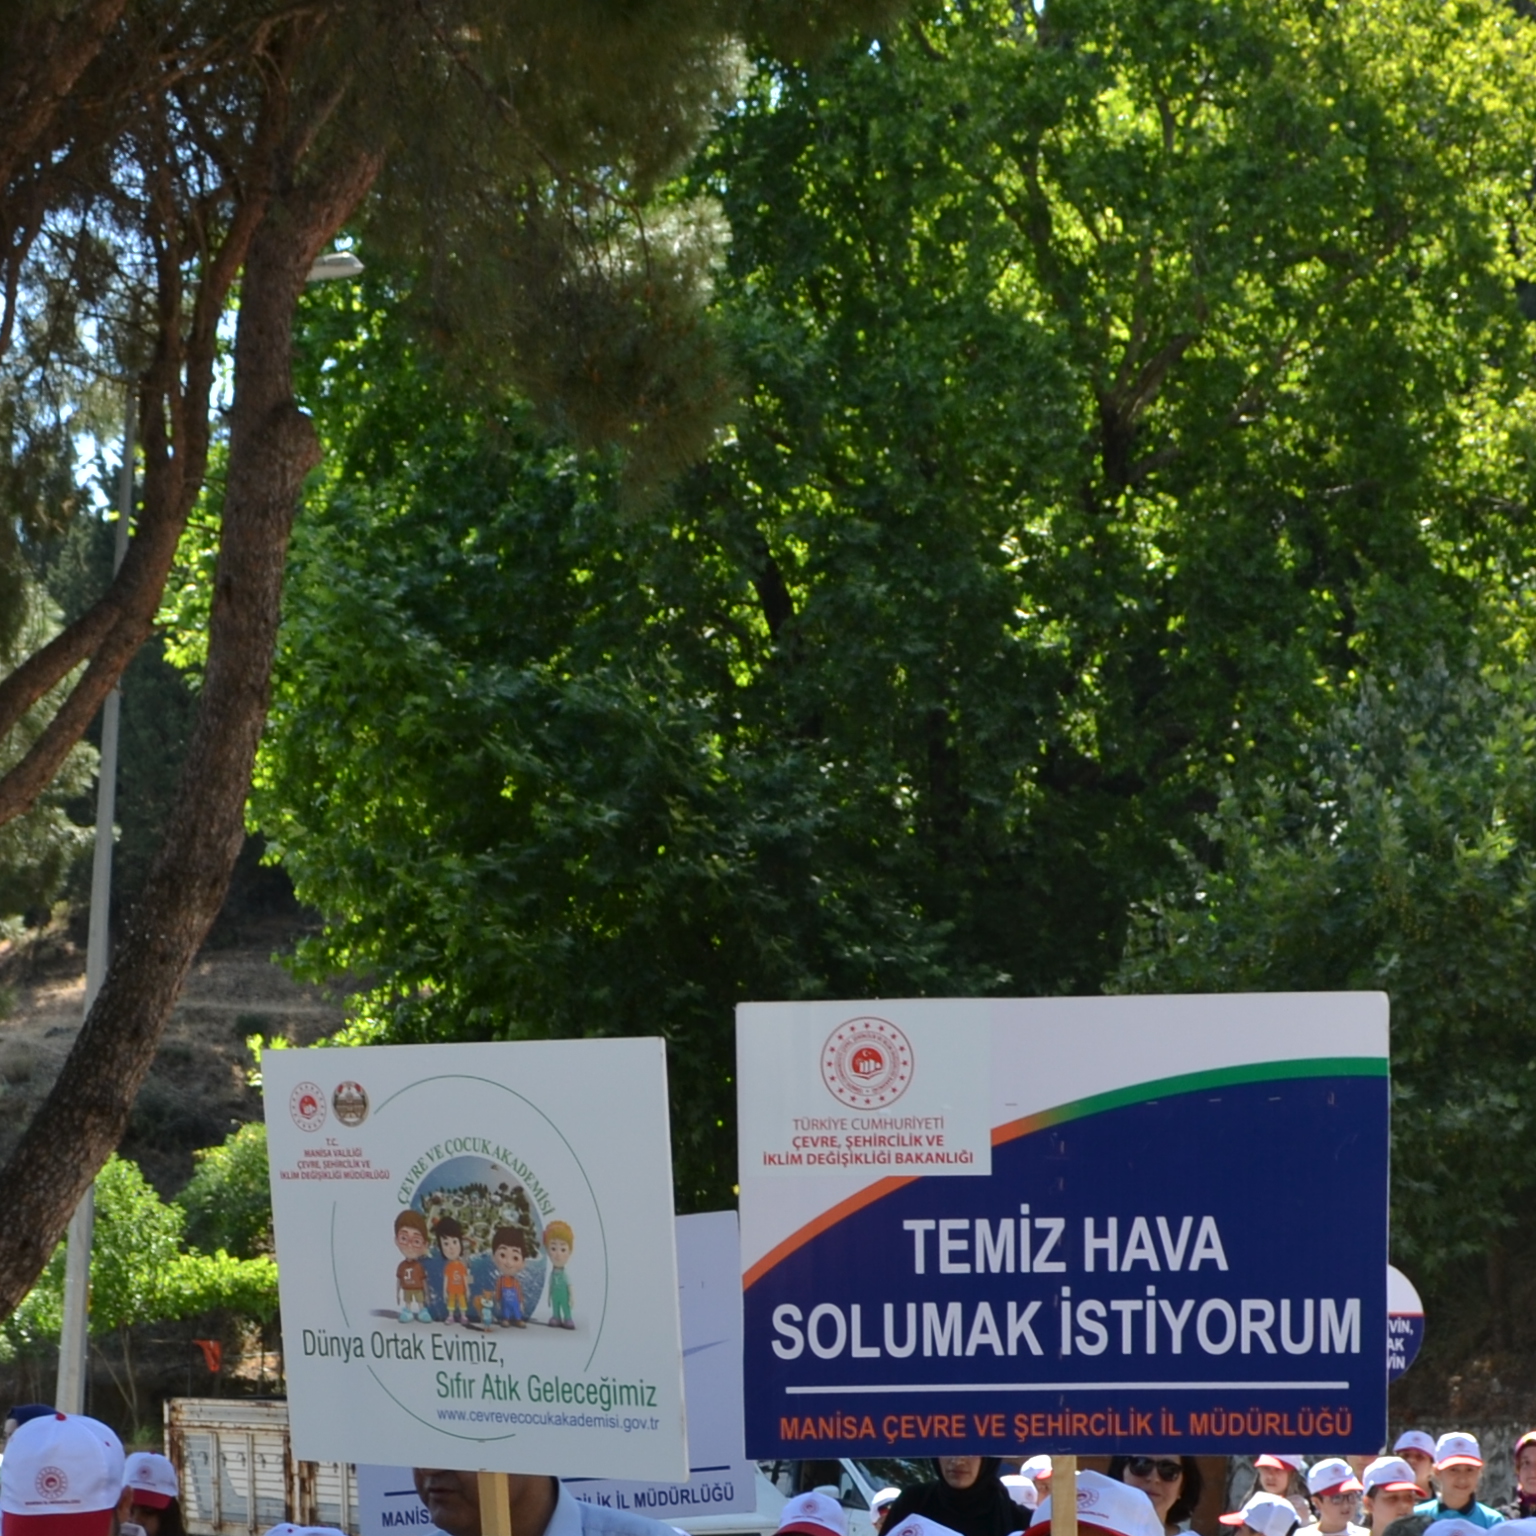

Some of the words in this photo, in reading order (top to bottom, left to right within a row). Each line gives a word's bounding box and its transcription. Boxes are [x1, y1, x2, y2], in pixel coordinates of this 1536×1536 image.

[792, 1135, 842, 1150] ÇEVRE,
[845, 1133, 923, 1150] ŞEHİRCİLİK
[926, 1135, 944, 1147] VE
[793, 1116, 848, 1131] TÜRKİYE
[851, 1115, 944, 1131] CUMHURİYETİ
[425, 1144, 445, 1164] VE
[444, 1136, 492, 1158] ÇOCUK
[490, 1144, 556, 1216] AKADEMİSİ
[763, 1151, 803, 1166] İKLİM
[806, 1149, 891, 1168] DEĞİŞİKLİĞİ
[894, 1149, 974, 1165] BAKANLIĞI
[903, 1204, 1066, 1274] TEMİZ
[1084, 1216, 1229, 1272] HAVA
[771, 1299, 1044, 1359] SOLUMAK
[1061, 1285, 1361, 1355] İSTİYORUM
[302, 1328, 366, 1364] Dünya
[371, 1331, 426, 1360] Ortak
[431, 1334, 505, 1367] Evimiz,
[435, 1371, 474, 1399] Sıfır
[481, 1373, 521, 1402] Atık
[527, 1374, 658, 1410] Geleceğimiz
[436, 1408, 660, 1432] www.cevrevecocukakademisi.gov.tr
[780, 1410, 876, 1441] MANİSA
[884, 1414, 967, 1444] ÇEVRE
[972, 1415, 1006, 1438] VE
[1014, 1407, 1153, 1443] ŞEHİRCİLİK
[1160, 1408, 1182, 1436] İL
[1188, 1406, 1352, 1437] MÜDÜRLÜĞÜ
[382, 1505, 434, 1527] MANİS
[616, 1490, 631, 1511] İL
[634, 1482, 735, 1509] MÜDÜRLÜĞÜ
